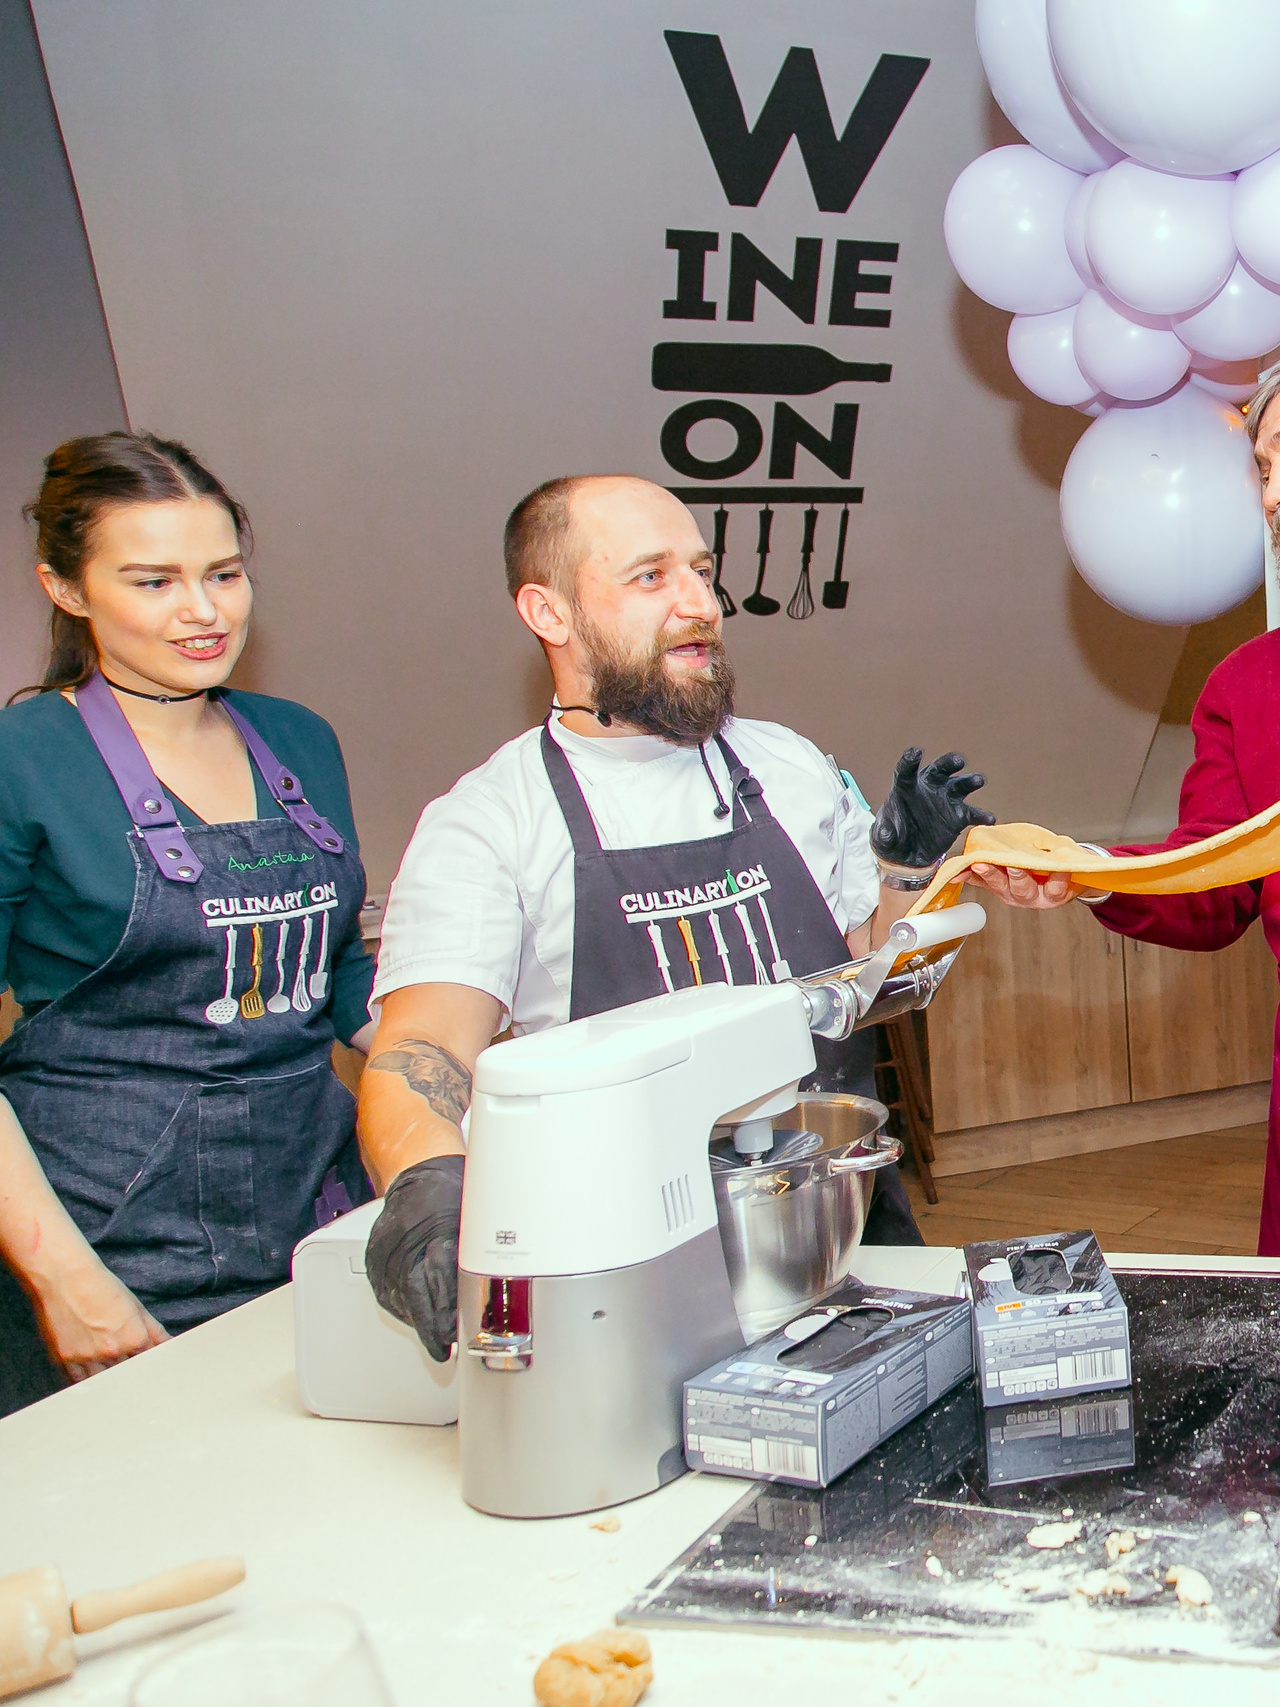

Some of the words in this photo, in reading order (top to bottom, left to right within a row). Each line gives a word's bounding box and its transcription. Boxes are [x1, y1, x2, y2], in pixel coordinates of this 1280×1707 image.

[664, 30, 931, 213] W
[662, 228, 899, 328] INE
[660, 399, 860, 480] ON
[202, 889, 305, 916] CULINARY
[310, 881, 337, 901] ON
[620, 879, 728, 912] CULINARY
[735, 864, 768, 888] ON
